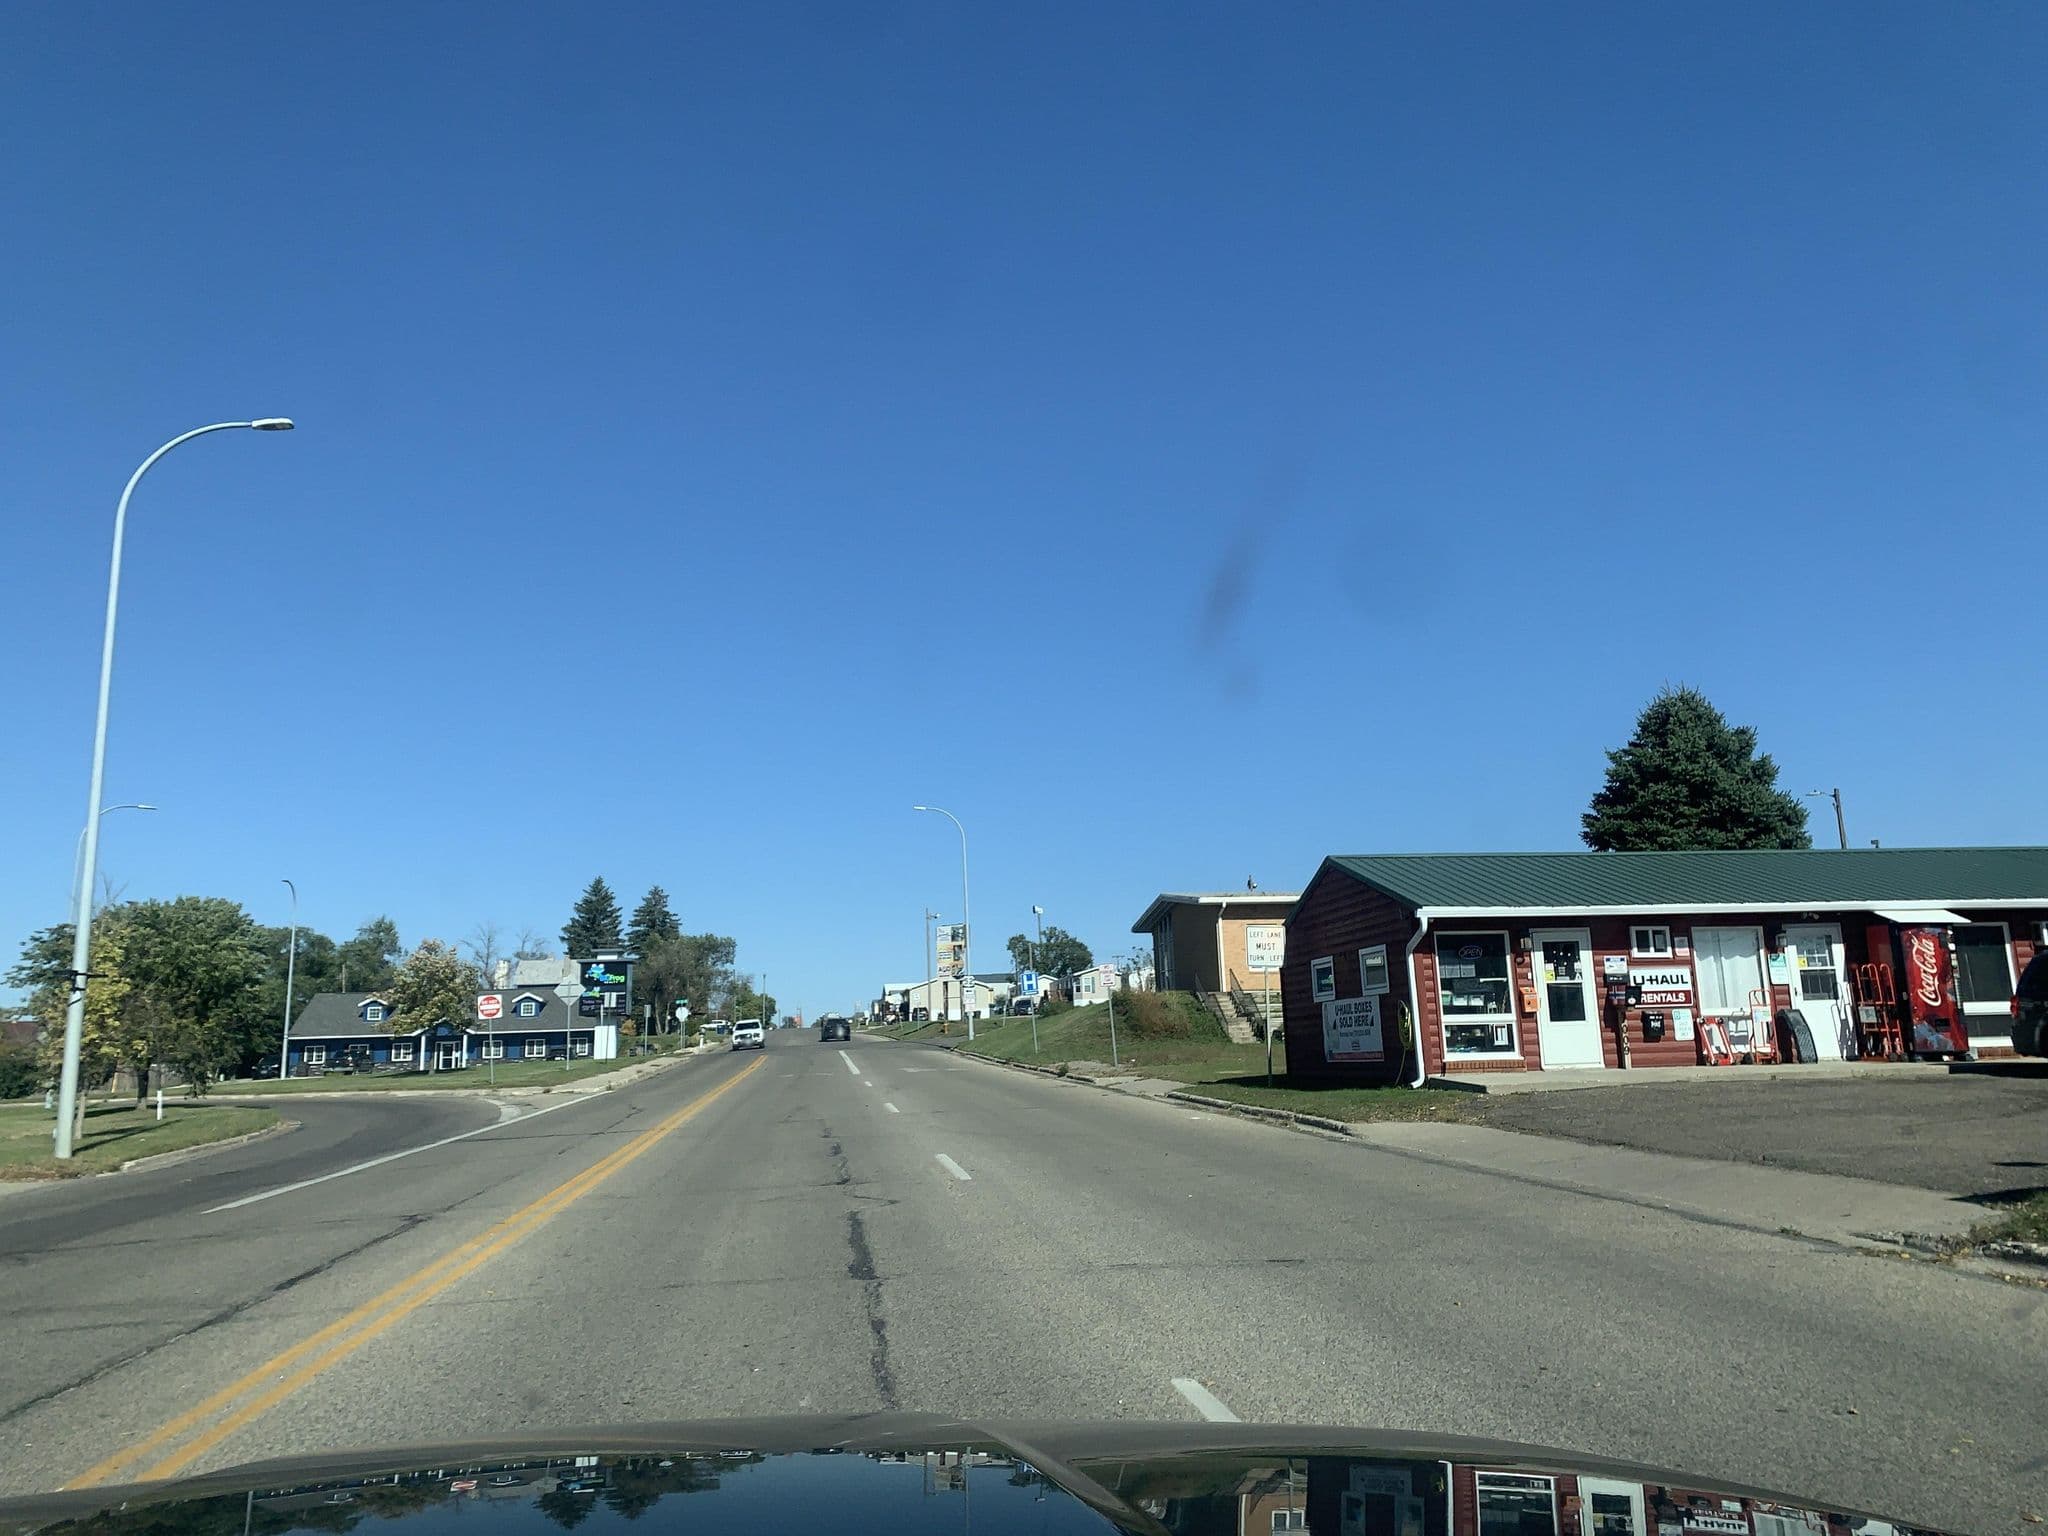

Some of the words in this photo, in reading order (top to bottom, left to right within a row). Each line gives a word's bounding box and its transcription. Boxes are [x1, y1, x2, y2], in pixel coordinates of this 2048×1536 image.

[1256, 942, 1275, 951] MUST
[1249, 954, 1265, 962] TURN
[1270, 954, 1283, 962] LEFT
[1023, 973, 1037, 991] H
[1633, 974, 1689, 986] U-HAUL
[1641, 992, 1686, 1003] RENTALS
[1339, 1016, 1353, 1029] SOLD
